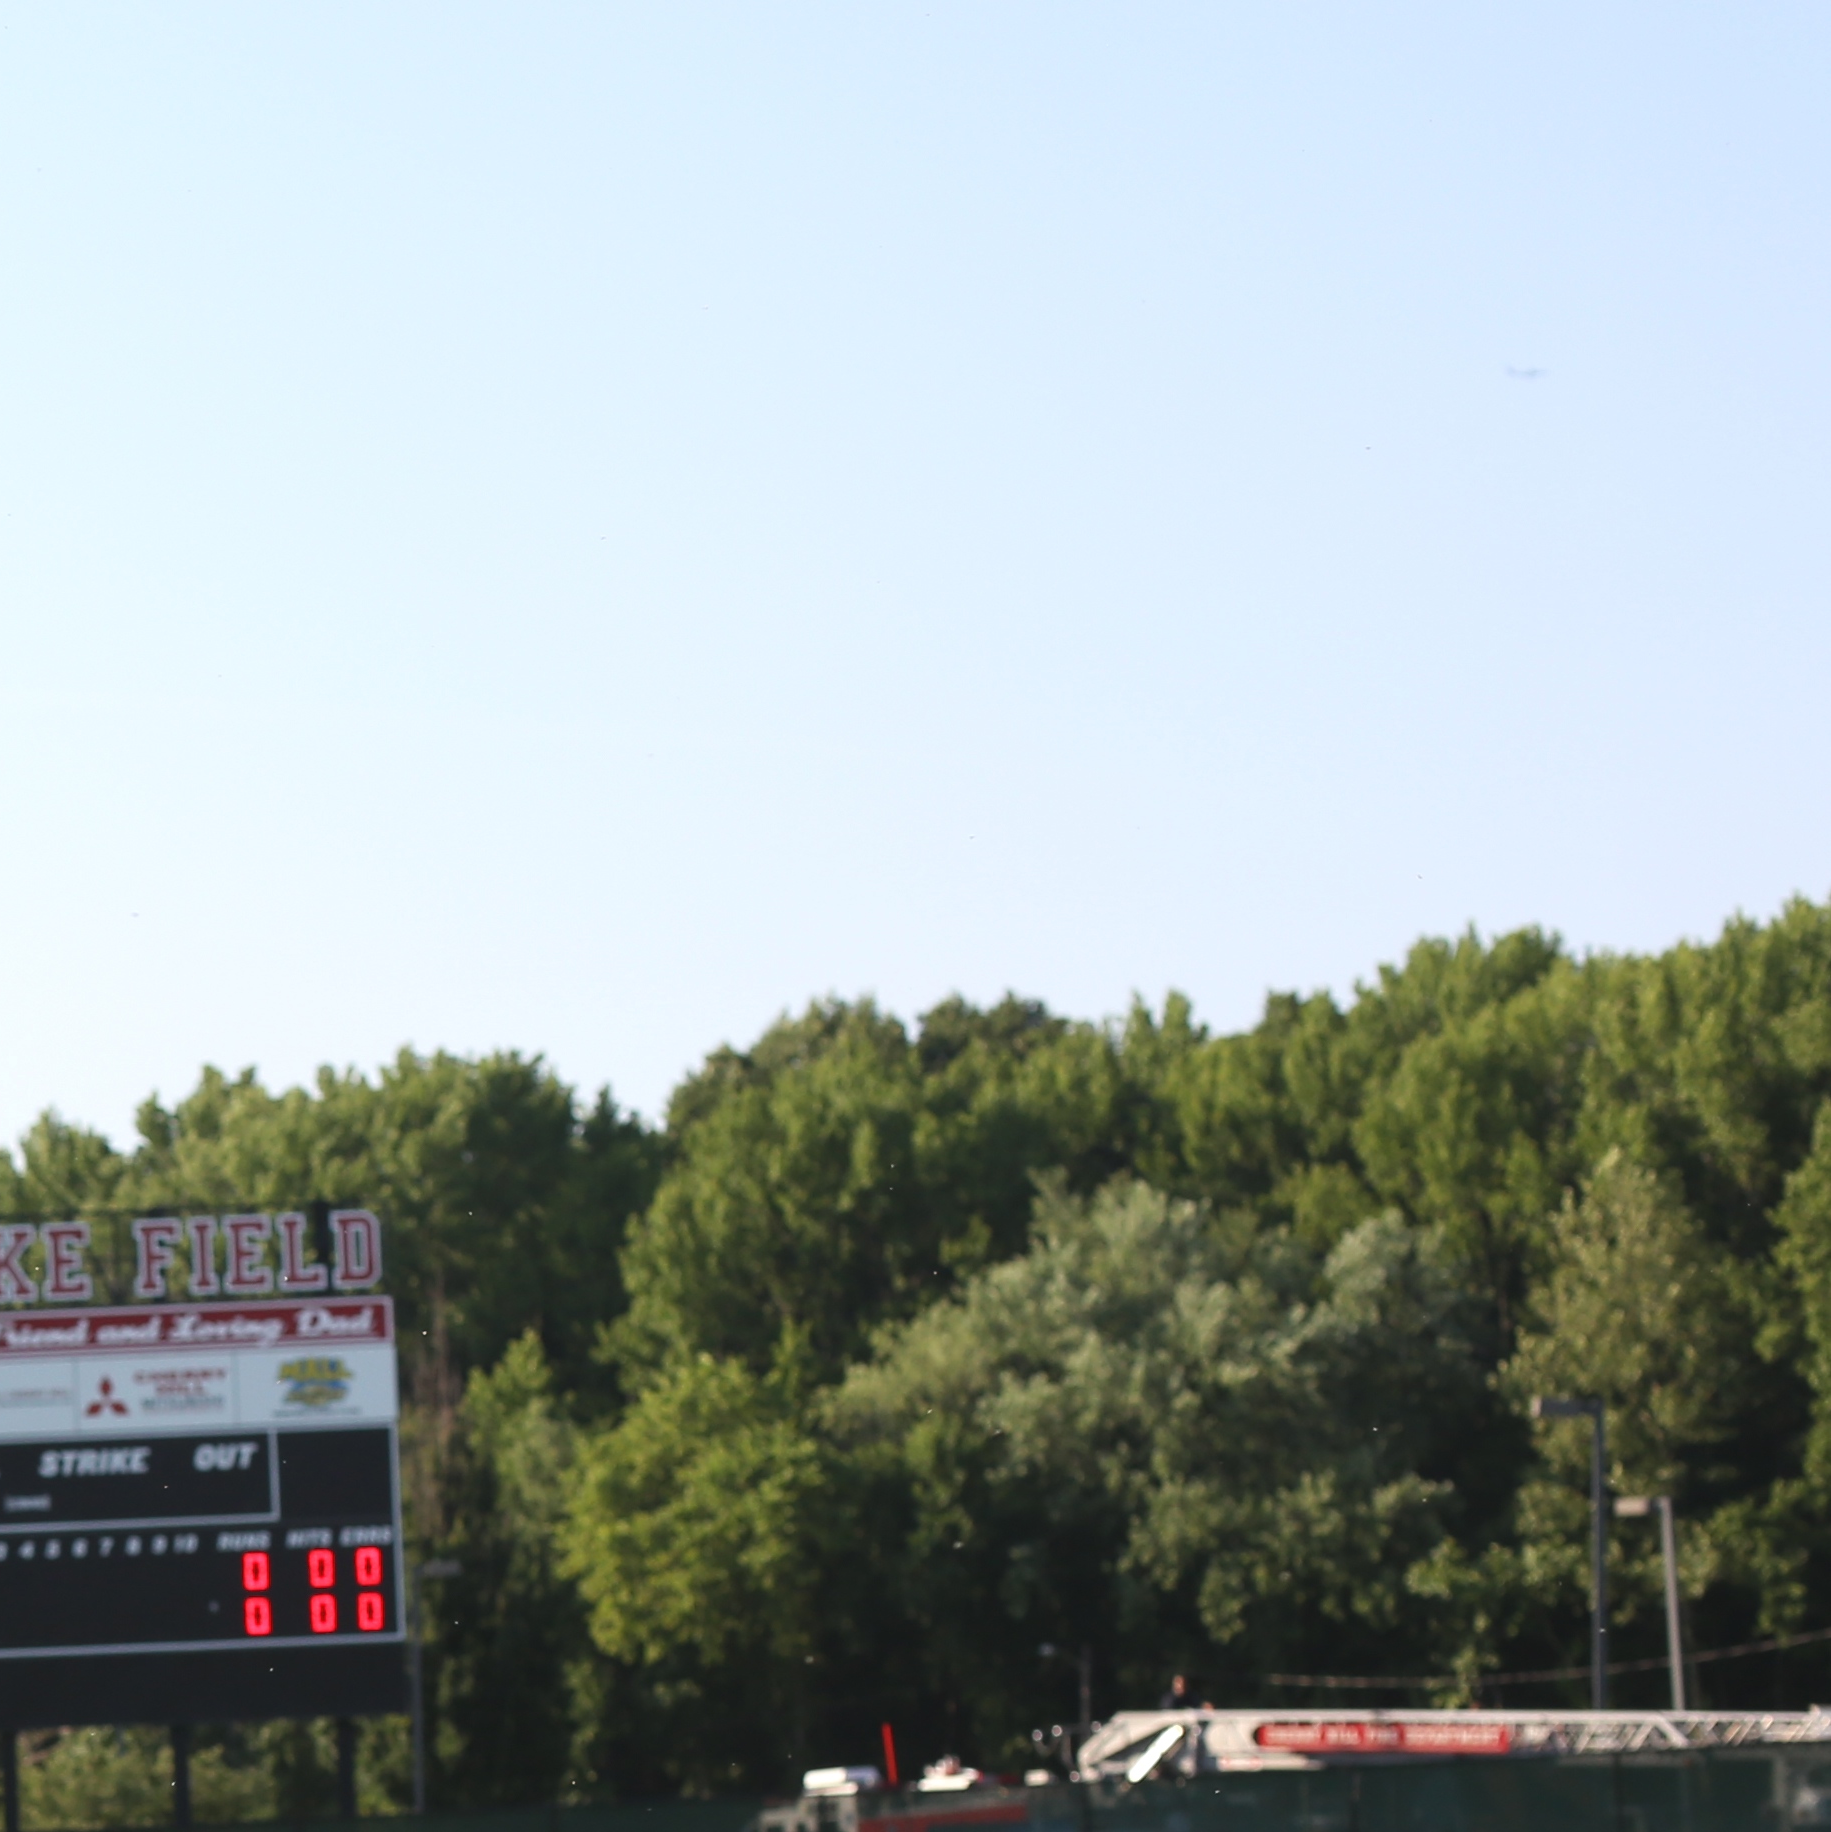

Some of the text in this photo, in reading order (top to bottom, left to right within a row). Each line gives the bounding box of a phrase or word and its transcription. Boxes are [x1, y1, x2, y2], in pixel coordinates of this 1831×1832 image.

[133, 1211, 382, 1297] FIELD
[96, 1315, 161, 1344] and
[169, 1311, 283, 1348] Loving
[297, 1306, 374, 1336] Dad
[39, 1446, 151, 1478] STRIKE
[194, 1442, 258, 1471] OUT
[18, 1540, 35, 1560] 4
[44, 1538, 61, 1559] 5
[71, 1537, 88, 1558] 6
[99, 1537, 114, 1557] 7
[125, 1535, 142, 1555] 8
[151, 1534, 168, 1554] 9
[174, 1533, 199, 1553] 10
[217, 1530, 272, 1551] RUNS
[286, 1528, 333, 1548] HITS
[243, 1546, 382, 1591] 0 0 0
[244, 1591, 384, 1636] 0 0 0
